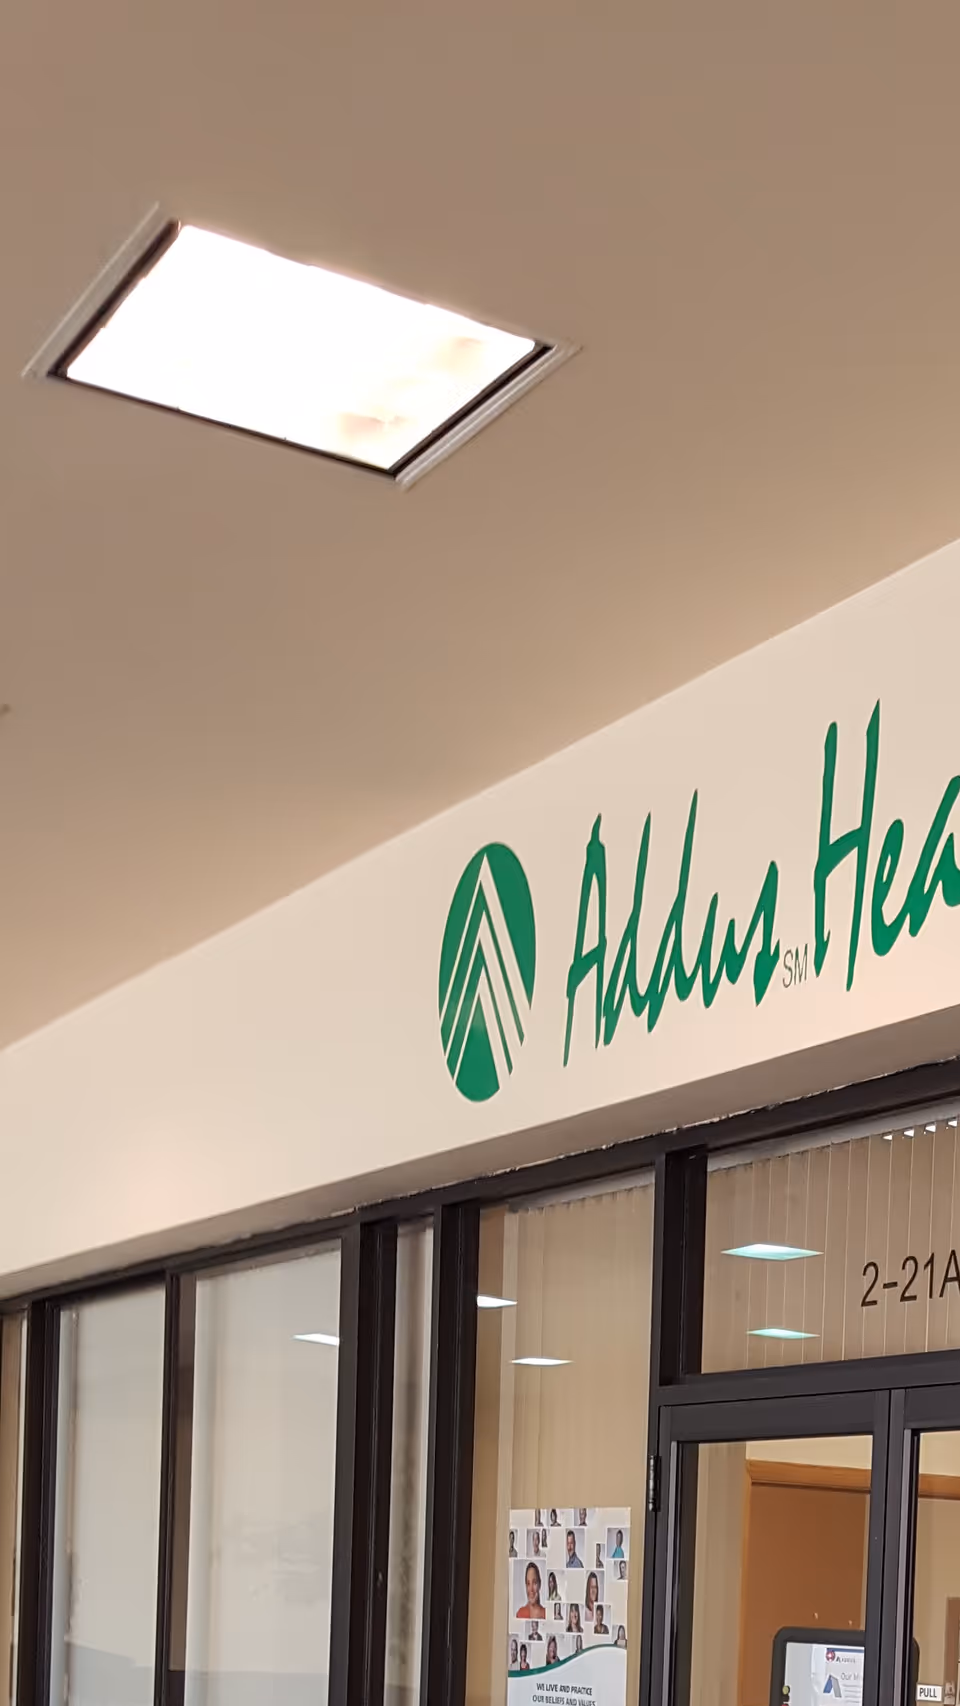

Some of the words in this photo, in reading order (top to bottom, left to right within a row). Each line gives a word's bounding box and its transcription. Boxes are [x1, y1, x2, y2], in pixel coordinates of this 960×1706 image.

[564, 789, 781, 1066] Addus
[783, 943, 807, 988] SM
[545, 1683, 559, 1693] LIVE
[919, 1687, 938, 1699] PULL
